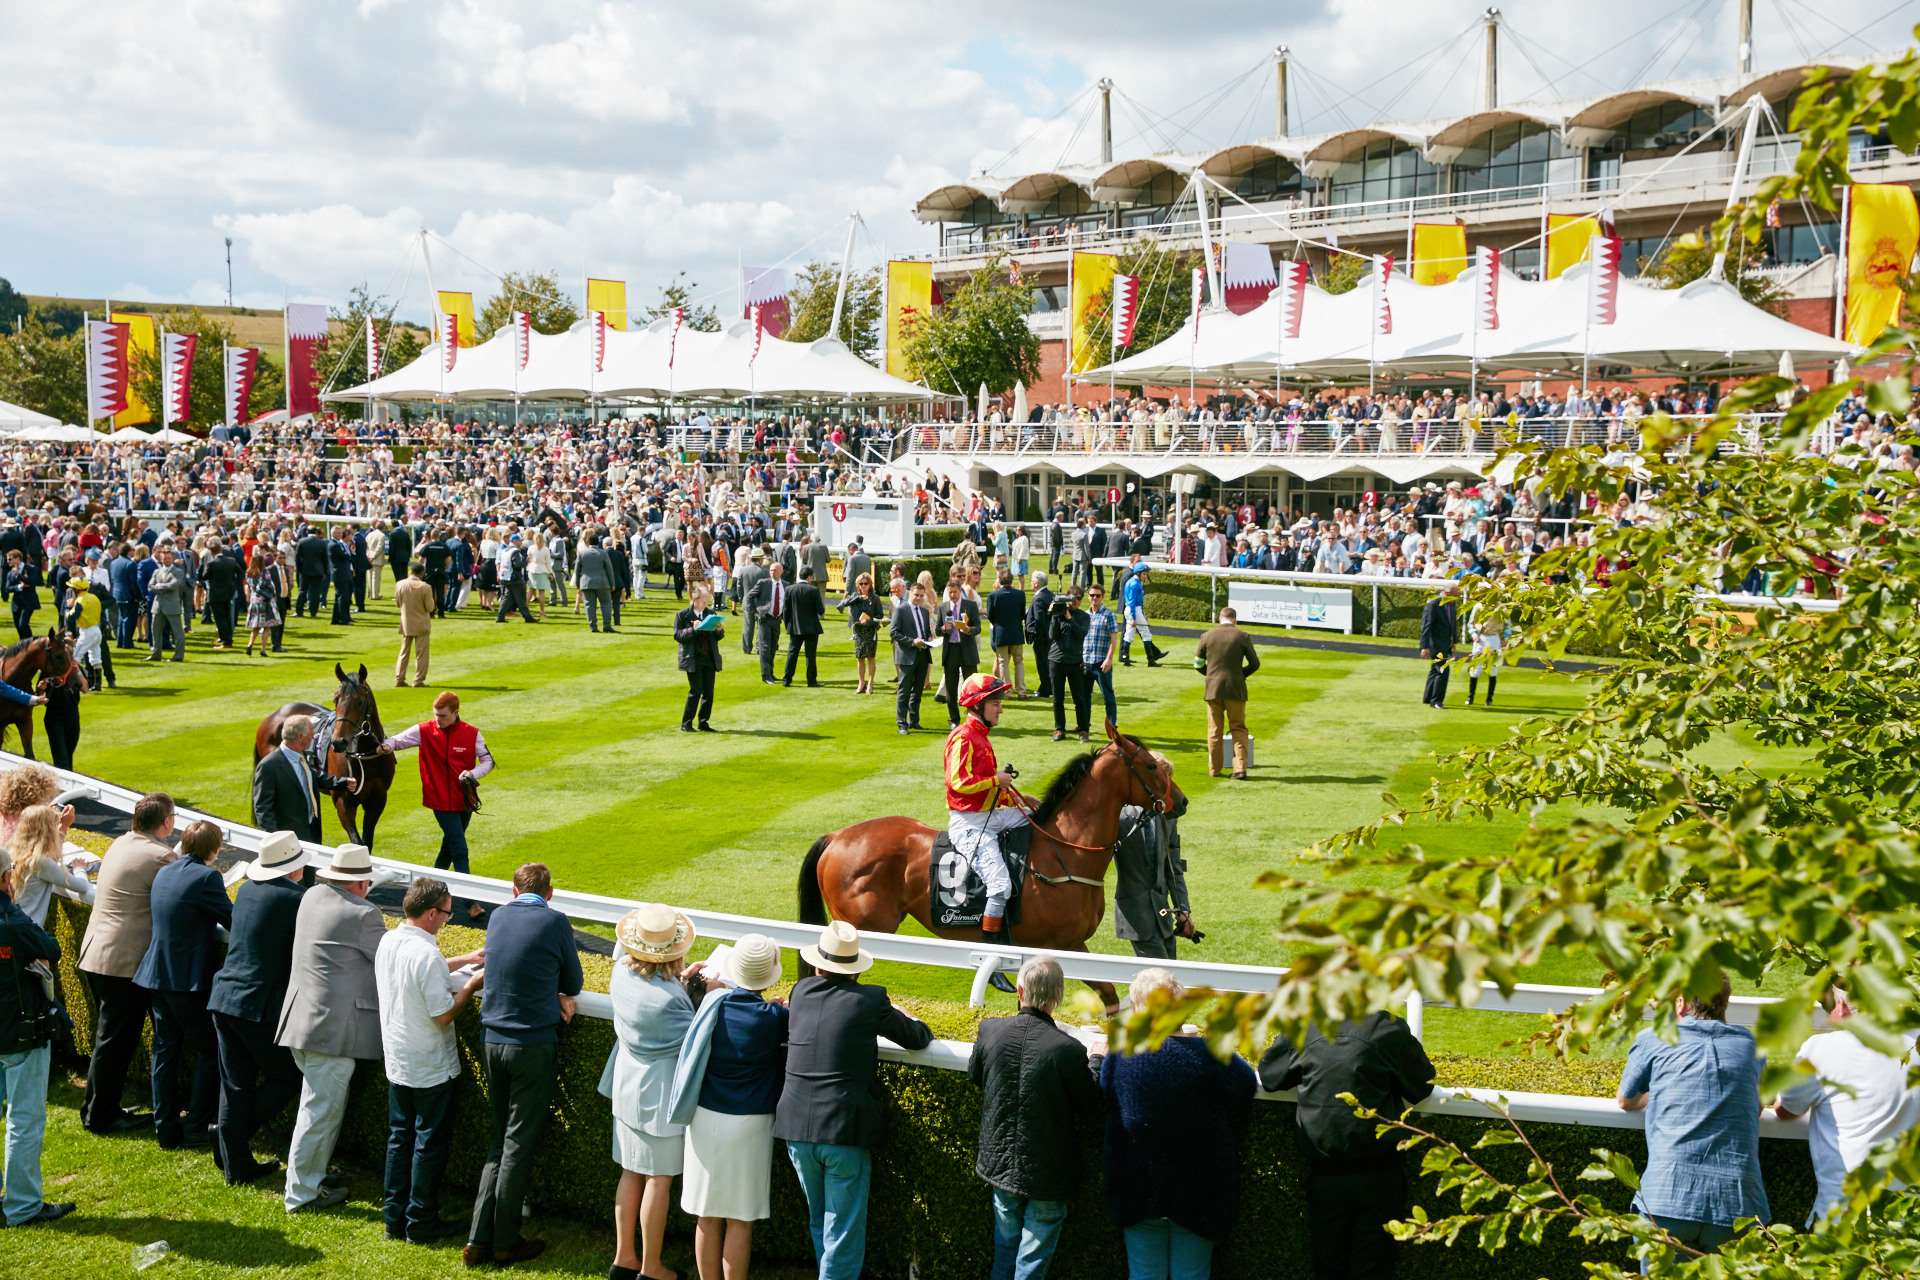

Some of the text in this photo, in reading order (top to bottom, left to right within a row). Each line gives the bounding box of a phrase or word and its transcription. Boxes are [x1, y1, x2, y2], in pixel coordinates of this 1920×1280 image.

[1110, 489, 1117, 503] 1
[1364, 491, 1374, 507] 2
[835, 504, 843, 521] 4
[1242, 506, 1252, 524] 3
[939, 851, 968, 907] 9
[940, 908, 983, 924] Fairmont
